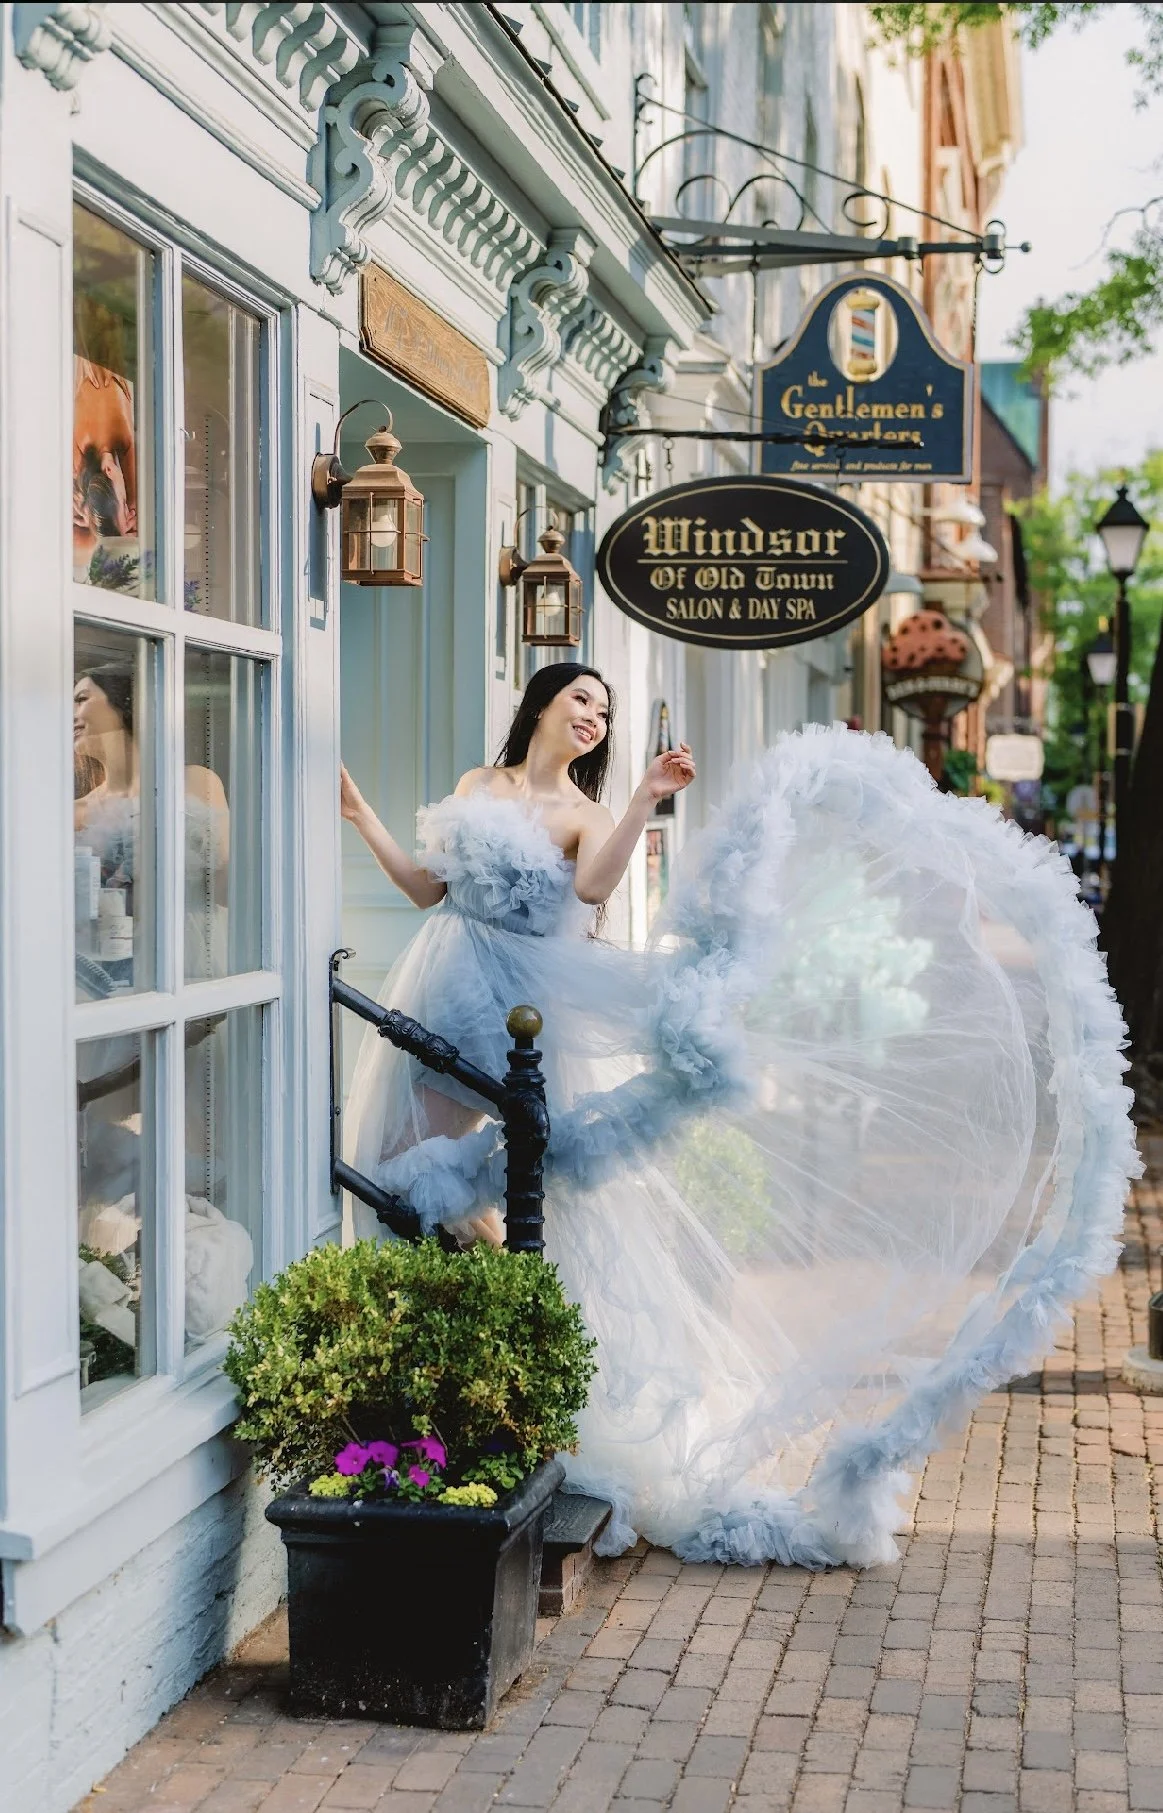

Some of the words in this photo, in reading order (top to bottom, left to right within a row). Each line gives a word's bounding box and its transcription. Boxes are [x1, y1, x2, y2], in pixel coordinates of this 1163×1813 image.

[807, 371, 828, 388] the
[780, 384, 944, 419] Gentlemen's
[845, 460, 862, 471] and
[898, 460, 912, 472] for
[641, 516, 847, 557] Windsor
[650, 566, 687, 591] Of
[695, 566, 746, 591] Old
[755, 566, 835, 591] Town
[666, 598, 724, 620] SALON
[728, 598, 743, 620] &
[748, 598, 782, 620] DAY
[785, 598, 817, 620] SPA
